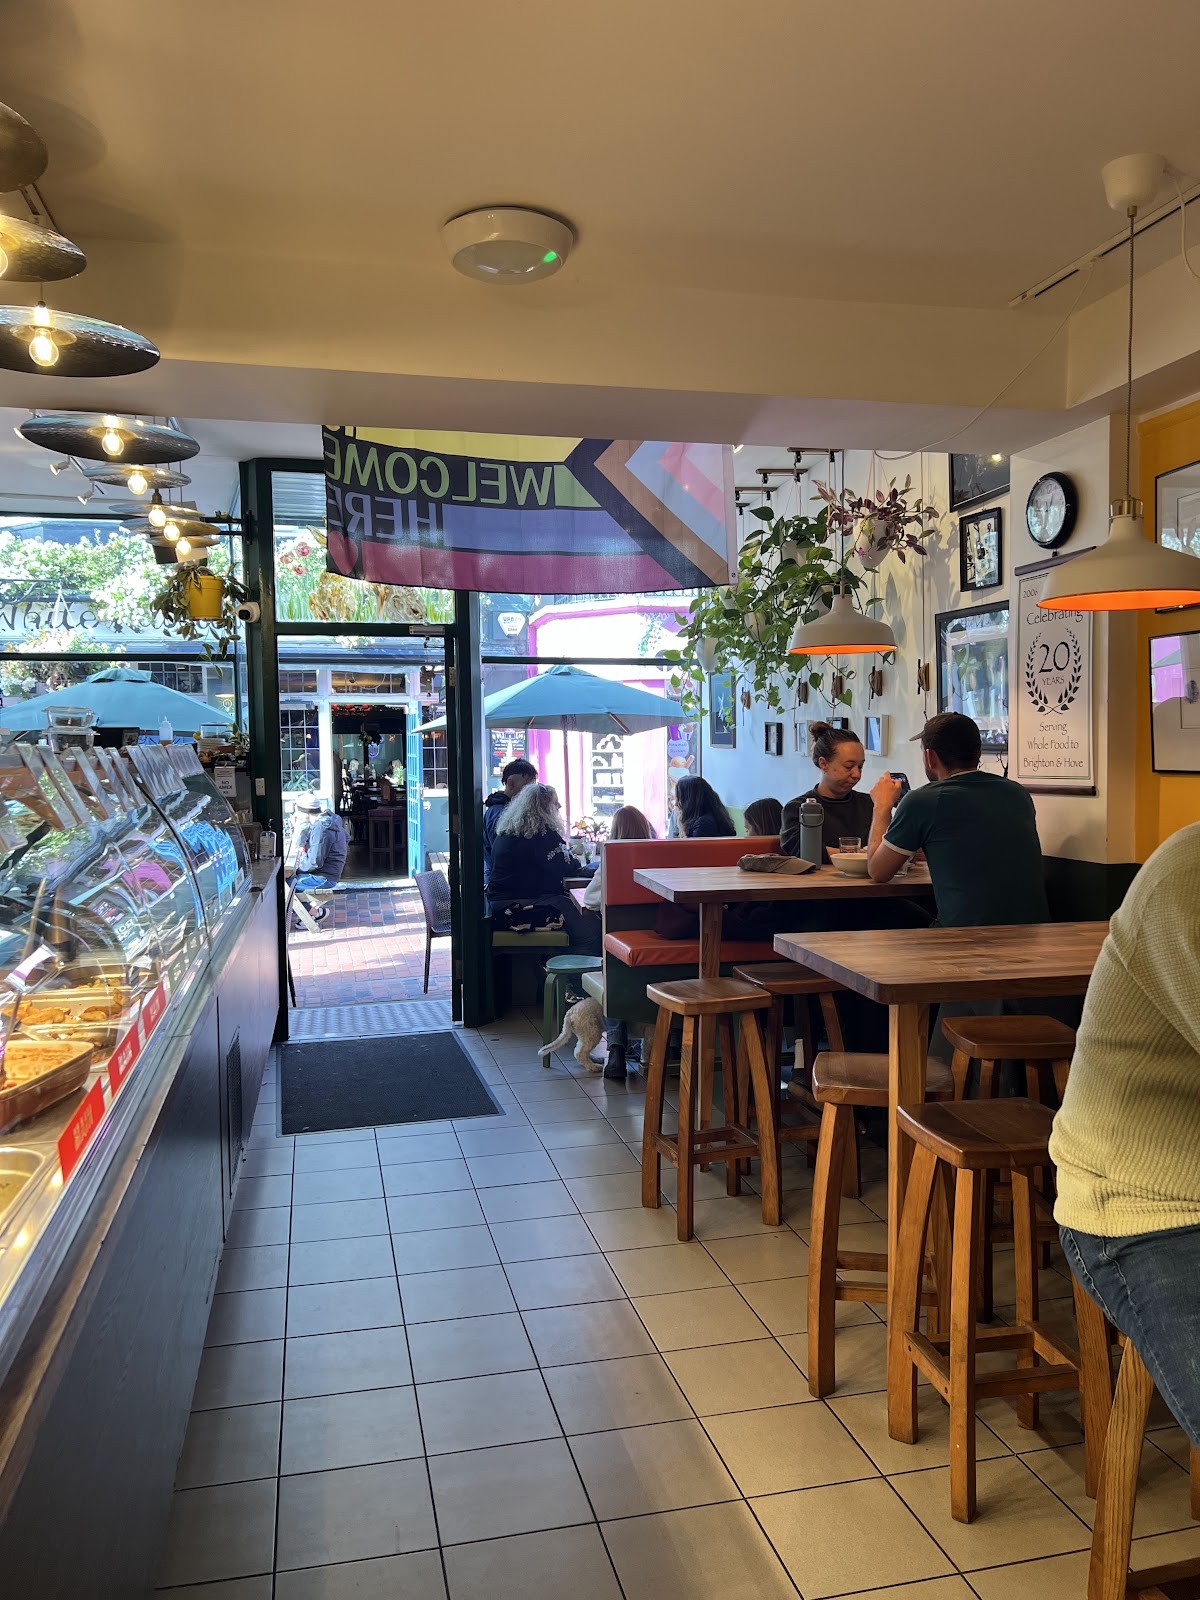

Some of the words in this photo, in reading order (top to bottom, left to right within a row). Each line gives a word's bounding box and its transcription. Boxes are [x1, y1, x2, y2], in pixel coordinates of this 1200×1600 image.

[1039, 641, 1070, 673] 20
[1042, 677, 1065, 686] YEARS
[1039, 721, 1067, 735] Serving
[1028, 737, 1049, 749] Whole
[1050, 736, 1069, 749] Food
[1071, 739, 1079, 749] to
[1023, 755, 1054, 772] Brighton
[1056, 758, 1062, 768] &
[1064, 758, 1083, 768] Hove
